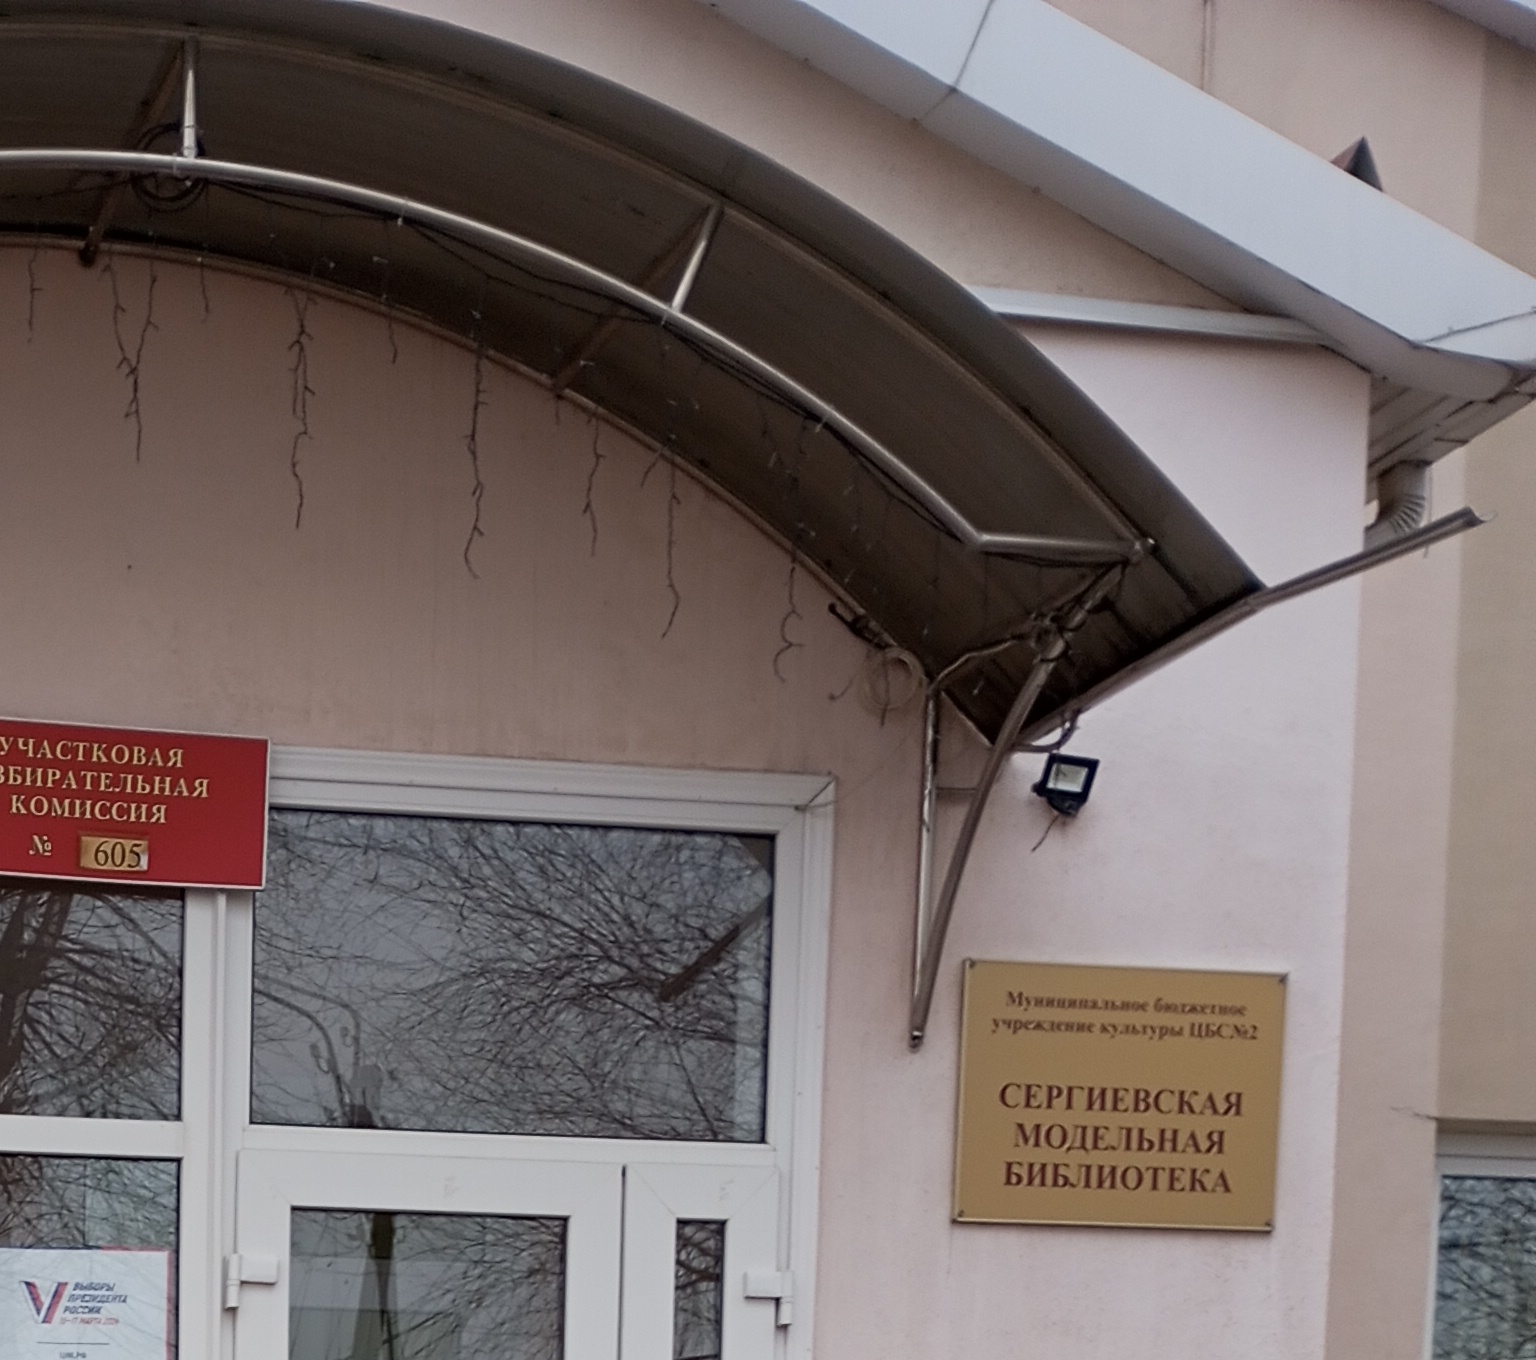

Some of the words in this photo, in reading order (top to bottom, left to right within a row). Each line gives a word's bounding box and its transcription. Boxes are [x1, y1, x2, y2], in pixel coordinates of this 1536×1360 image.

[0, 736, 183, 768] УЧАСТКОВАЯ
[10, 795, 166, 823] КОМИССИЯ
[29, 835, 52, 856] №
[94, 841, 142, 868] 605
[1005, 991, 1148, 1013] Муниципальное
[1154, 998, 1247, 1017] бюджетное
[991, 1017, 1094, 1034] учреждение
[1100, 1023, 1183, 1040] культуры
[999, 1082, 1243, 1116] СЕРГИЕВСКАЯ
[1014, 1123, 1225, 1155] МОДЕЛЬНАЯ
[1004, 1161, 1231, 1193] БИБЛИОТЕКА
[73, 1282, 115, 1291] ВЫБОРЫ
